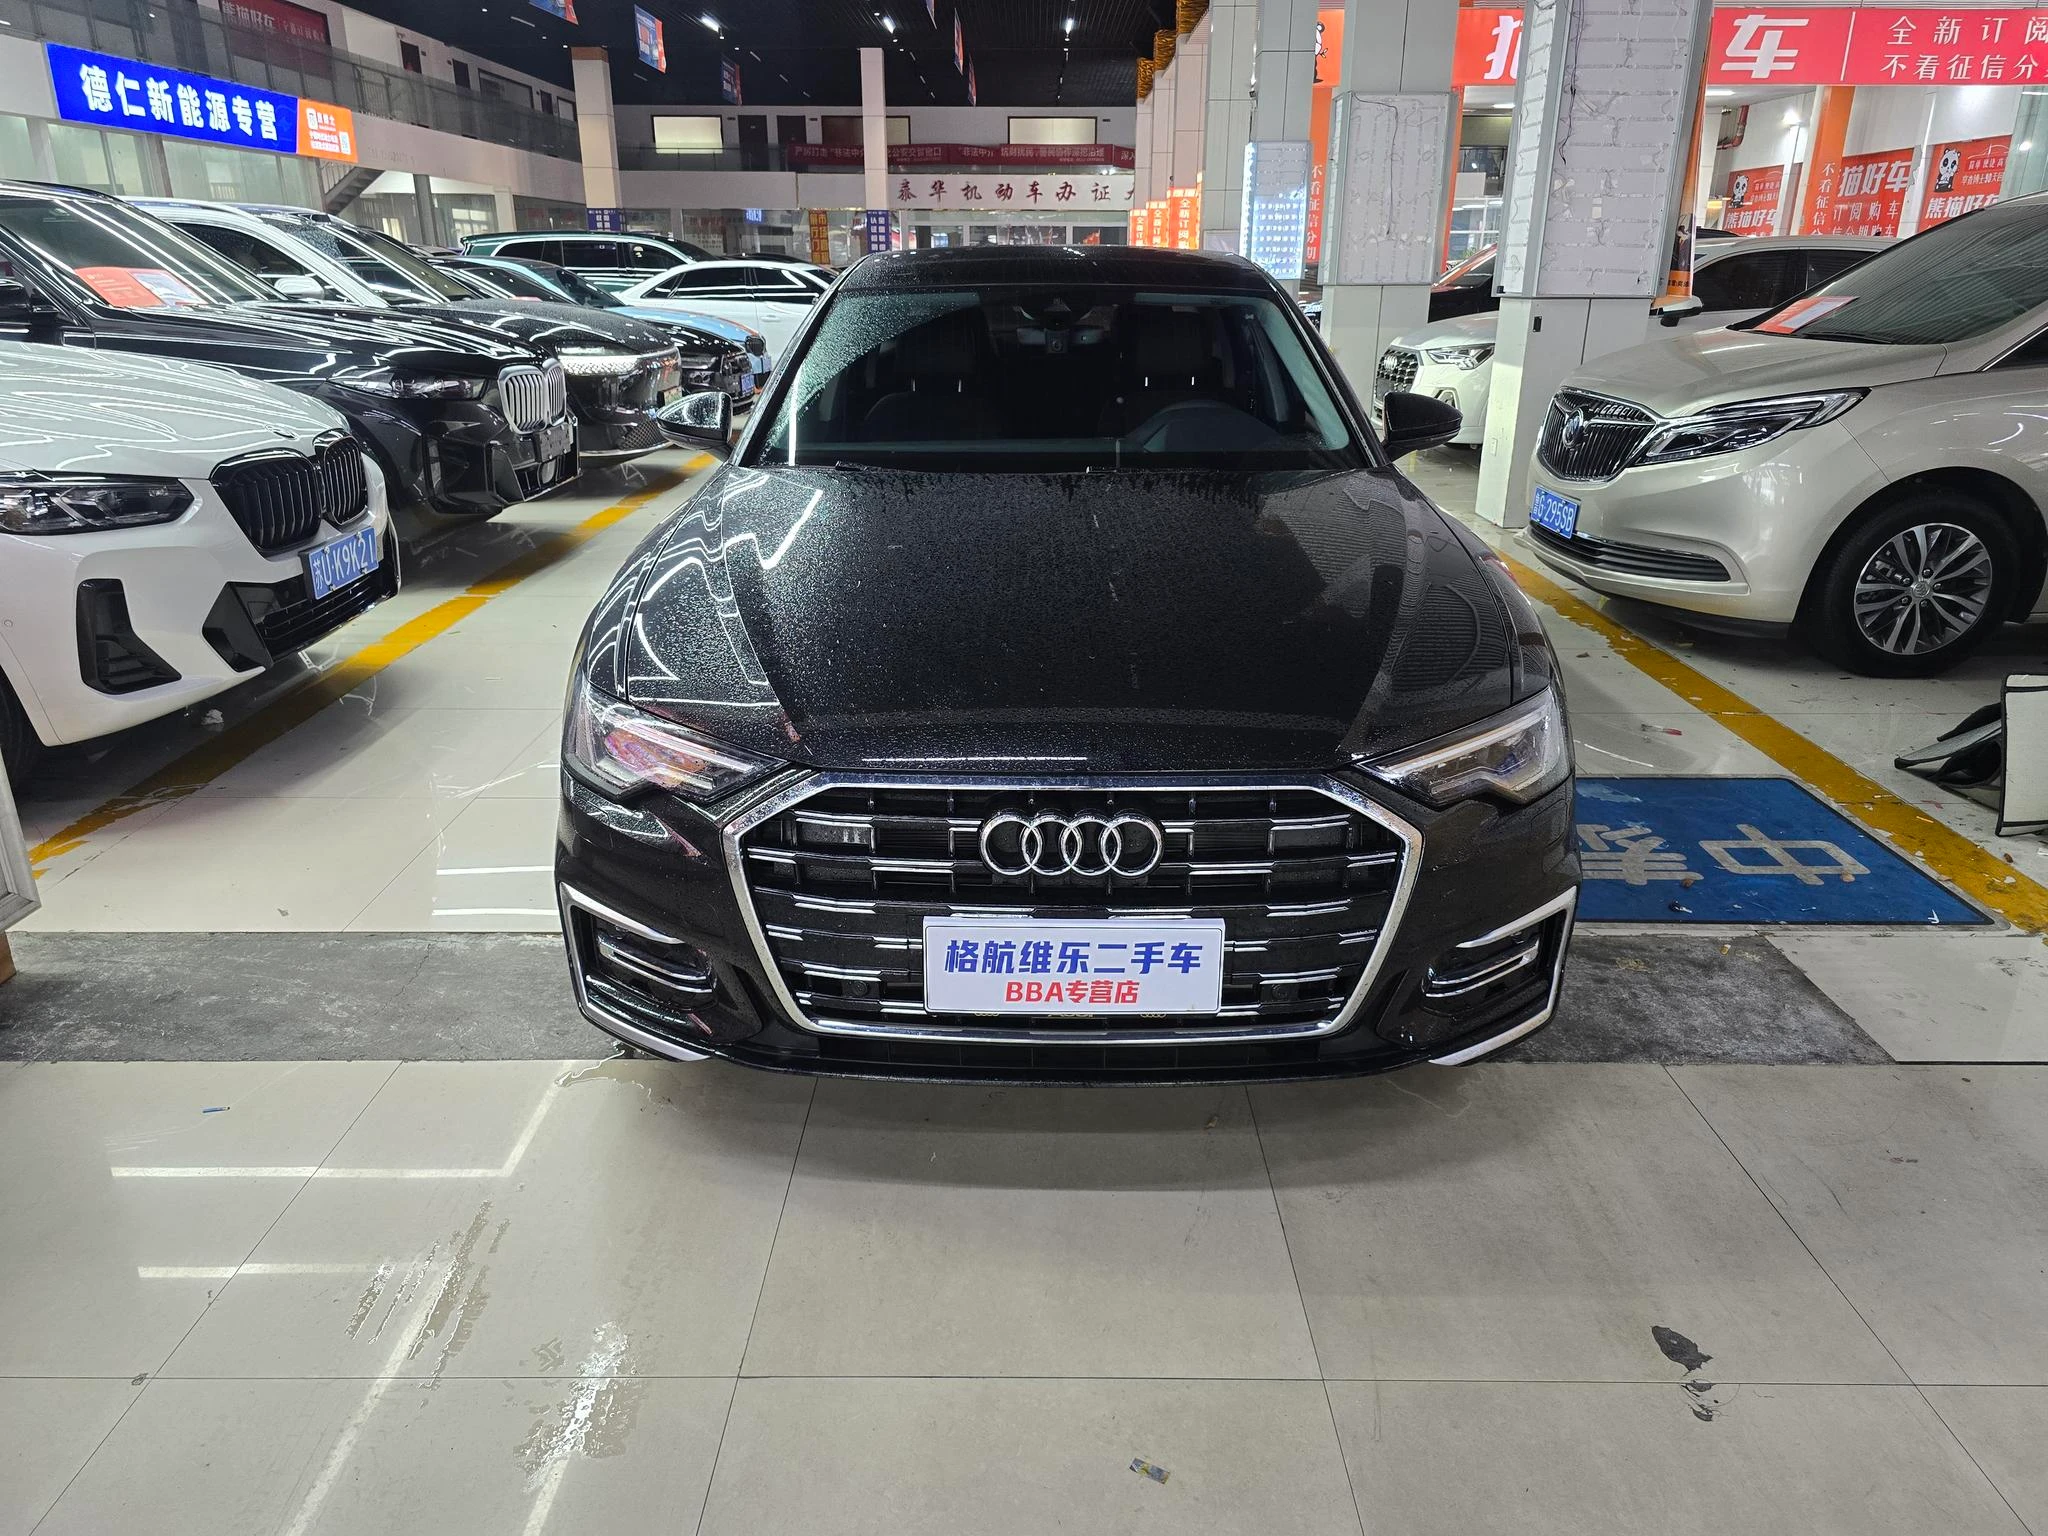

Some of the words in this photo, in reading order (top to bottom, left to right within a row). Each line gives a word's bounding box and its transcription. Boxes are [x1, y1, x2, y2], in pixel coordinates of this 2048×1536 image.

[1717, 14, 1809, 79] 车
[1886, 15, 2048, 45] 全新订阅
[1880, 53, 2048, 81] 不看征信分
[79, 63, 278, 141] 德仁新能源专营
[1838, 160, 1912, 198] 猫好车
[944, 939, 1203, 975] 格航维乐二手车
[1004, 980, 1141, 1004] BBA专营店
